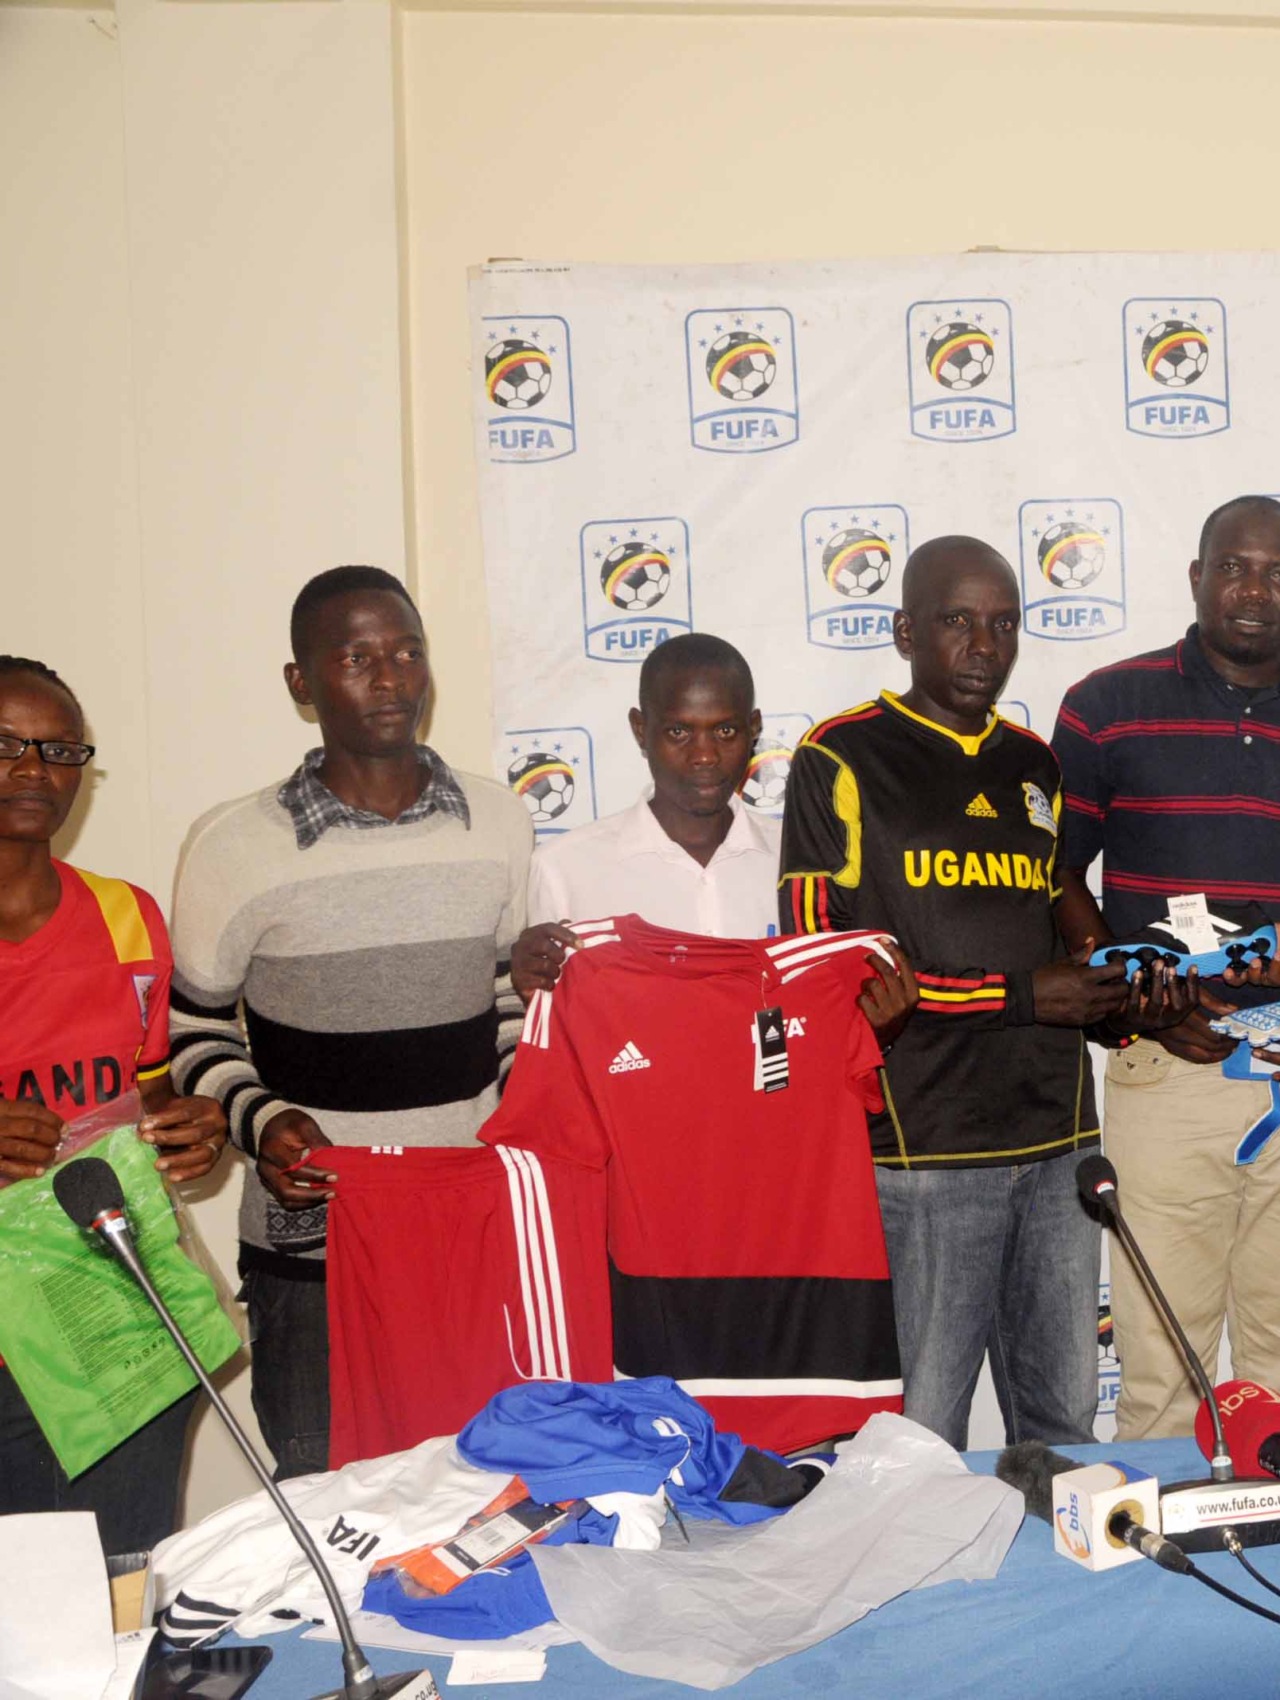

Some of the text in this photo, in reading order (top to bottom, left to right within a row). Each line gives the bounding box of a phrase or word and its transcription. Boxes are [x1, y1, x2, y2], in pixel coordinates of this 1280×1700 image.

[930, 408, 996, 429] FUFA
[1144, 405, 1209, 425] FUFA
[489, 429, 555, 449] FUFA
[711, 418, 779, 441] FUFA
[827, 615, 893, 636] FUFA
[1041, 607, 1106, 627] FUFA
[965, 808, 998, 818] adidas
[904, 849, 1046, 890] UGANDA
[608, 1059, 651, 1074] adidas
